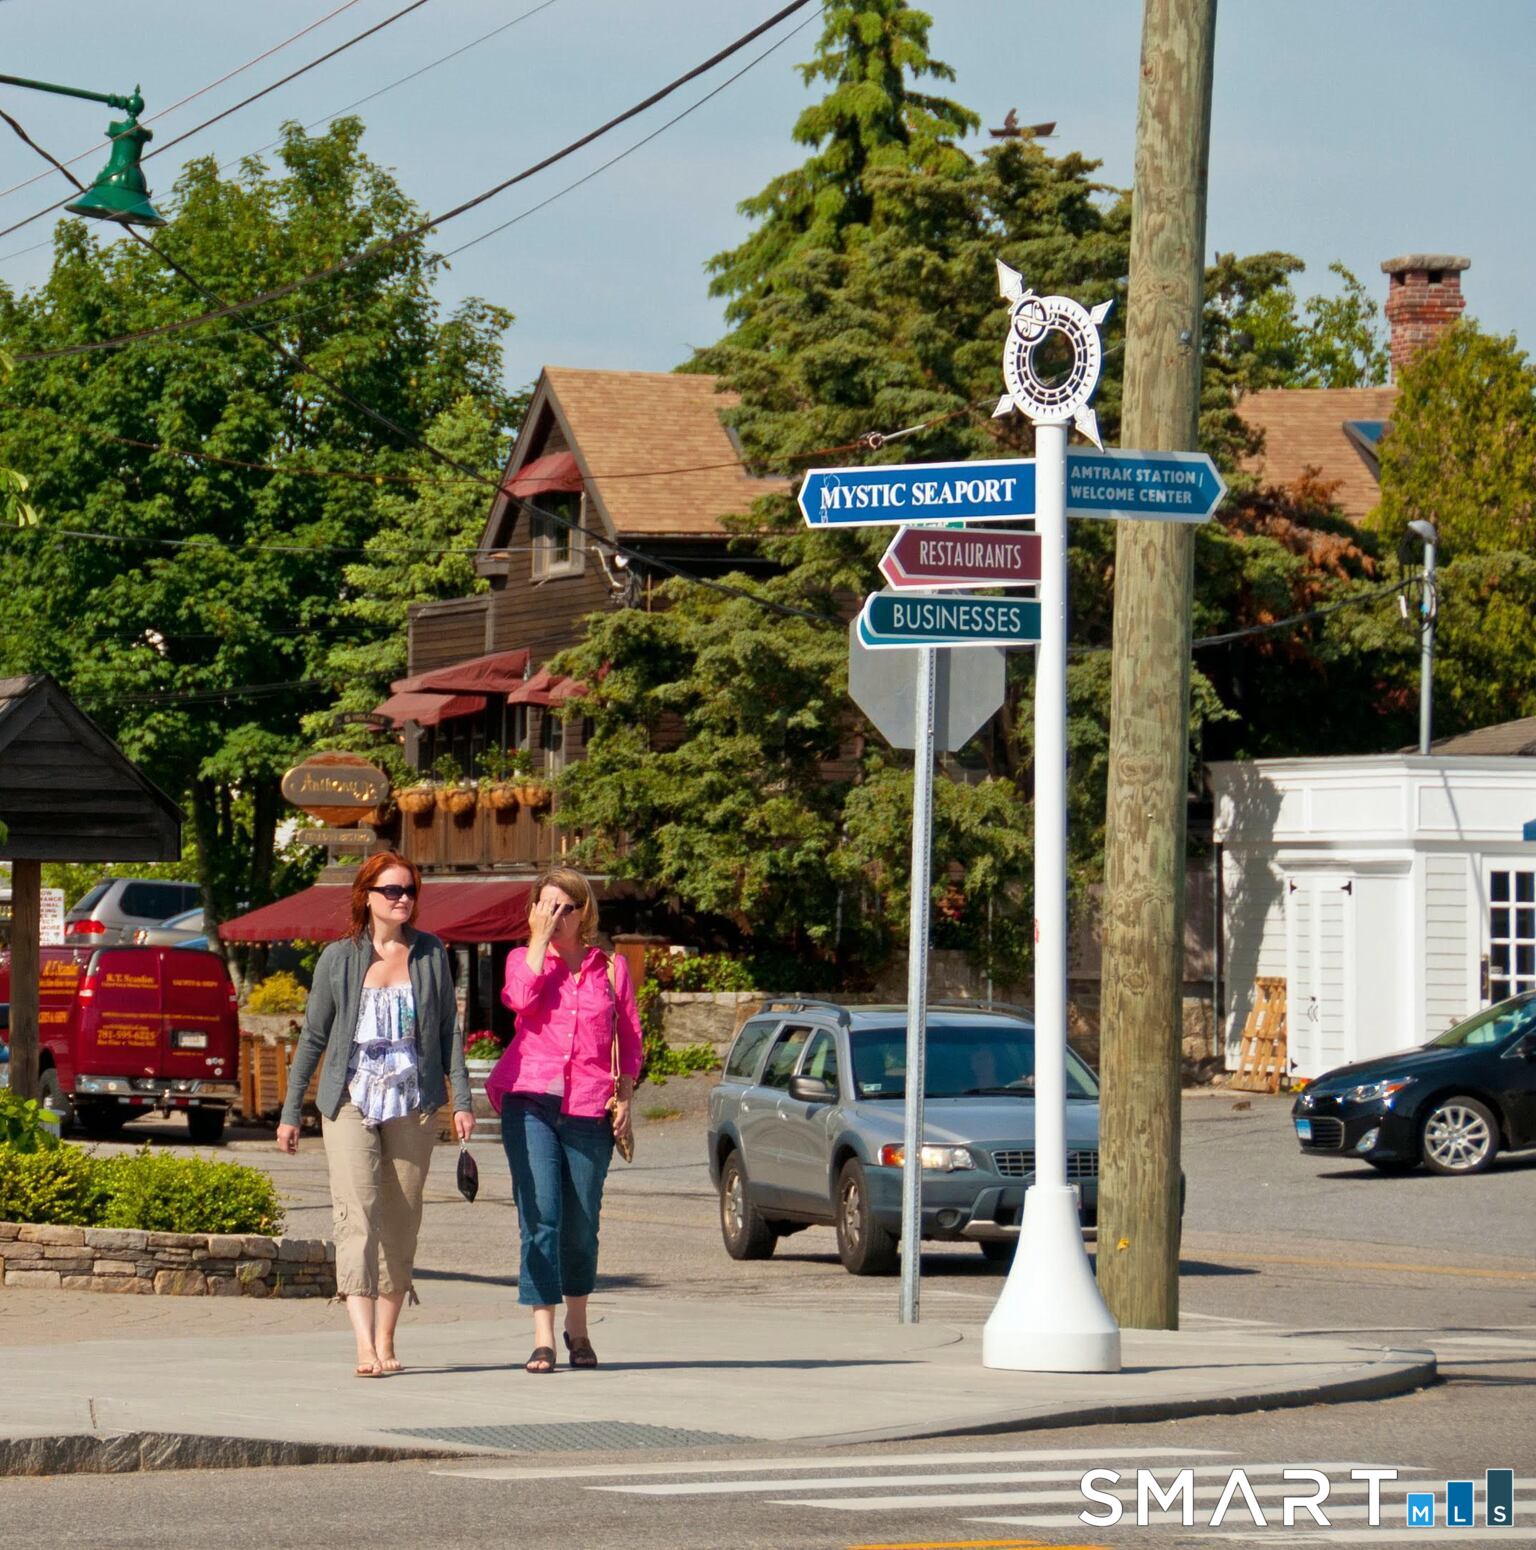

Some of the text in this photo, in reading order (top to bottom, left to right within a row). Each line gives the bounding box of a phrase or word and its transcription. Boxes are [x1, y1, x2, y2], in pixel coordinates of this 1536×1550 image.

[1070, 465, 1132, 481] AMTRAK
[1135, 468, 1196, 484] STATION
[820, 478, 1017, 510] MYSTIC SEAPORT
[1070, 485, 1193, 504] WELCOME CENTER
[919, 540, 1022, 569] RESTAURANTS
[893, 603, 1021, 633] BUSINESSES
